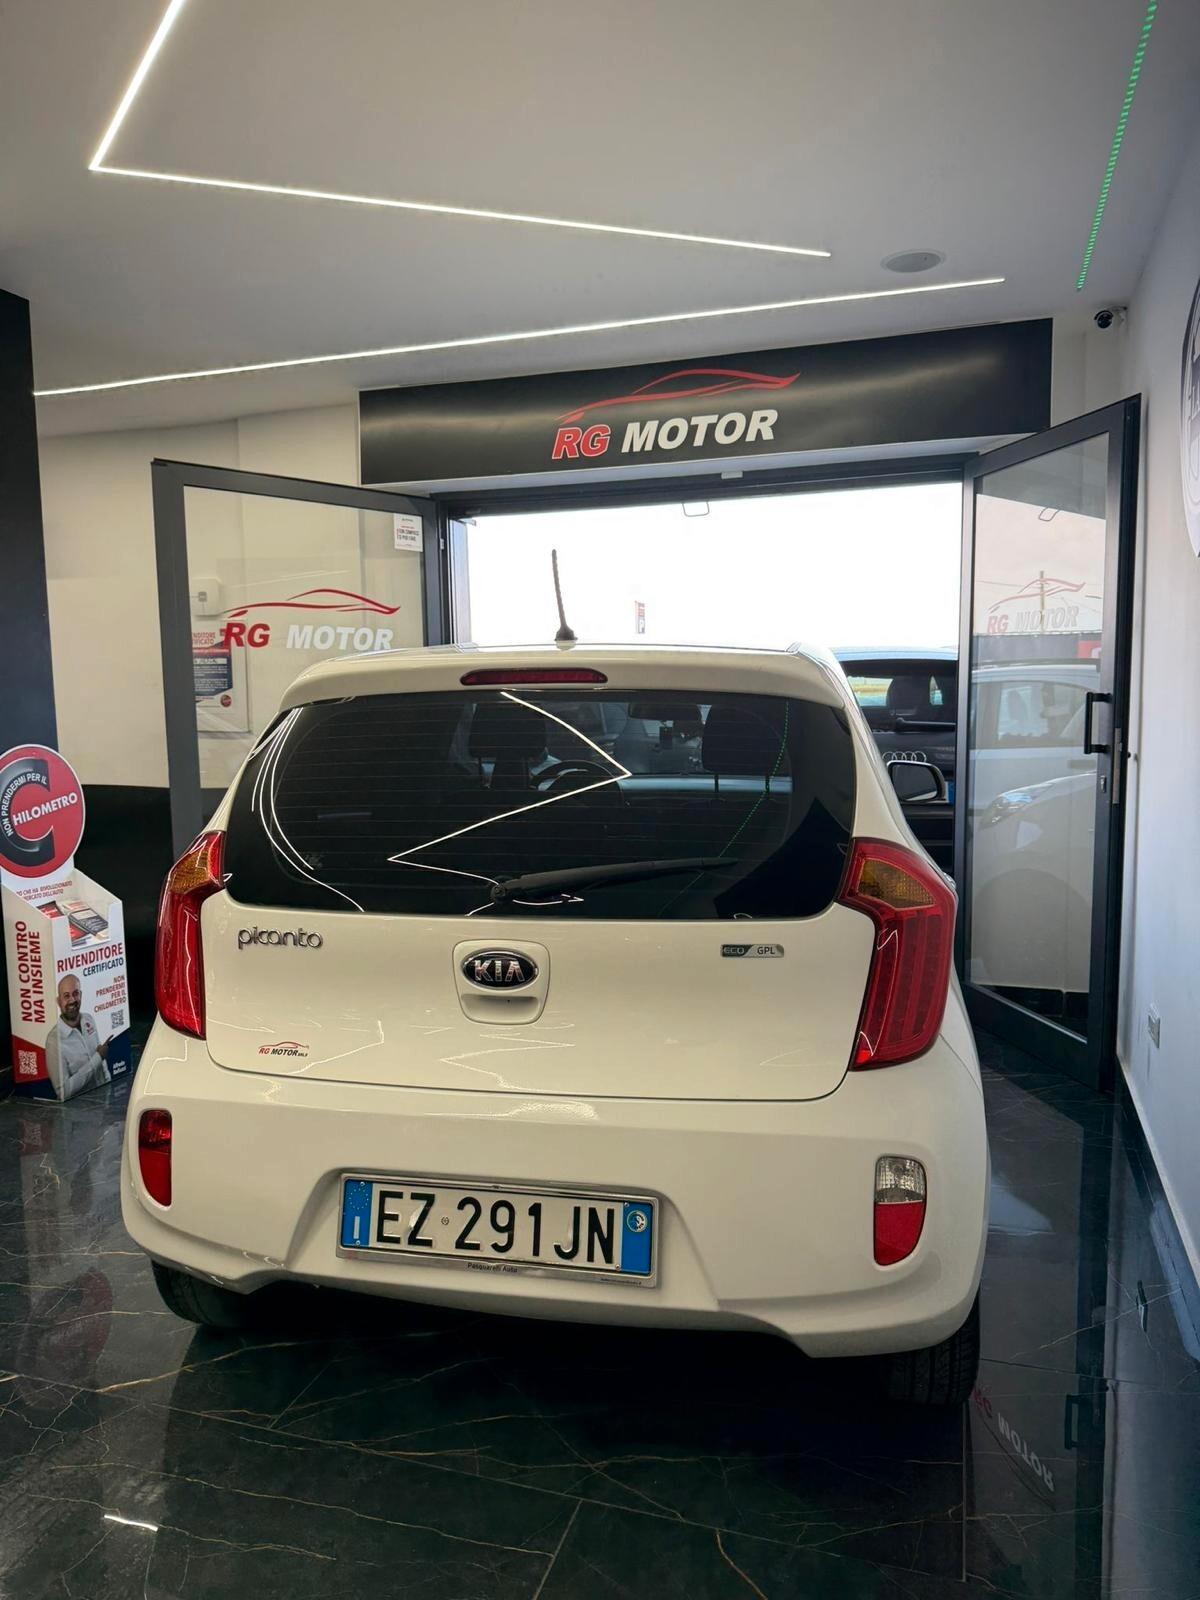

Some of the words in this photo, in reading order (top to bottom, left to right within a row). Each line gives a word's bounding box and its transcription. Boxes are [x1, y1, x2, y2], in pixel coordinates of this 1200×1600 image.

[552, 424, 611, 460] RG
[621, 409, 778, 453] MOTOR
[222, 622, 271, 648] RG
[286, 624, 394, 650] MOTOR
[26, 773, 41, 782] PER
[1, 774, 27, 816] PRENDERMI
[2, 818, 14, 837] NON
[238, 926, 323, 950] picanto
[757, 946, 776, 955] GPL
[15, 921, 30, 983] CONTRO
[28, 931, 43, 994] INSIEME
[57, 942, 123, 973] RIVENDITORE
[82, 957, 124, 977] CERTIFICATO
[473, 960, 526, 982] KIA
[20, 988, 33, 1022] NON
[33, 999, 46, 1023] MA
[259, 1047, 270, 1055] RG
[271, 1048, 298, 1057] MOTOR
[376, 1190, 436, 1247] EZ
[455, 1196, 542, 1257] 291
[553, 1206, 615, 1264] JN
